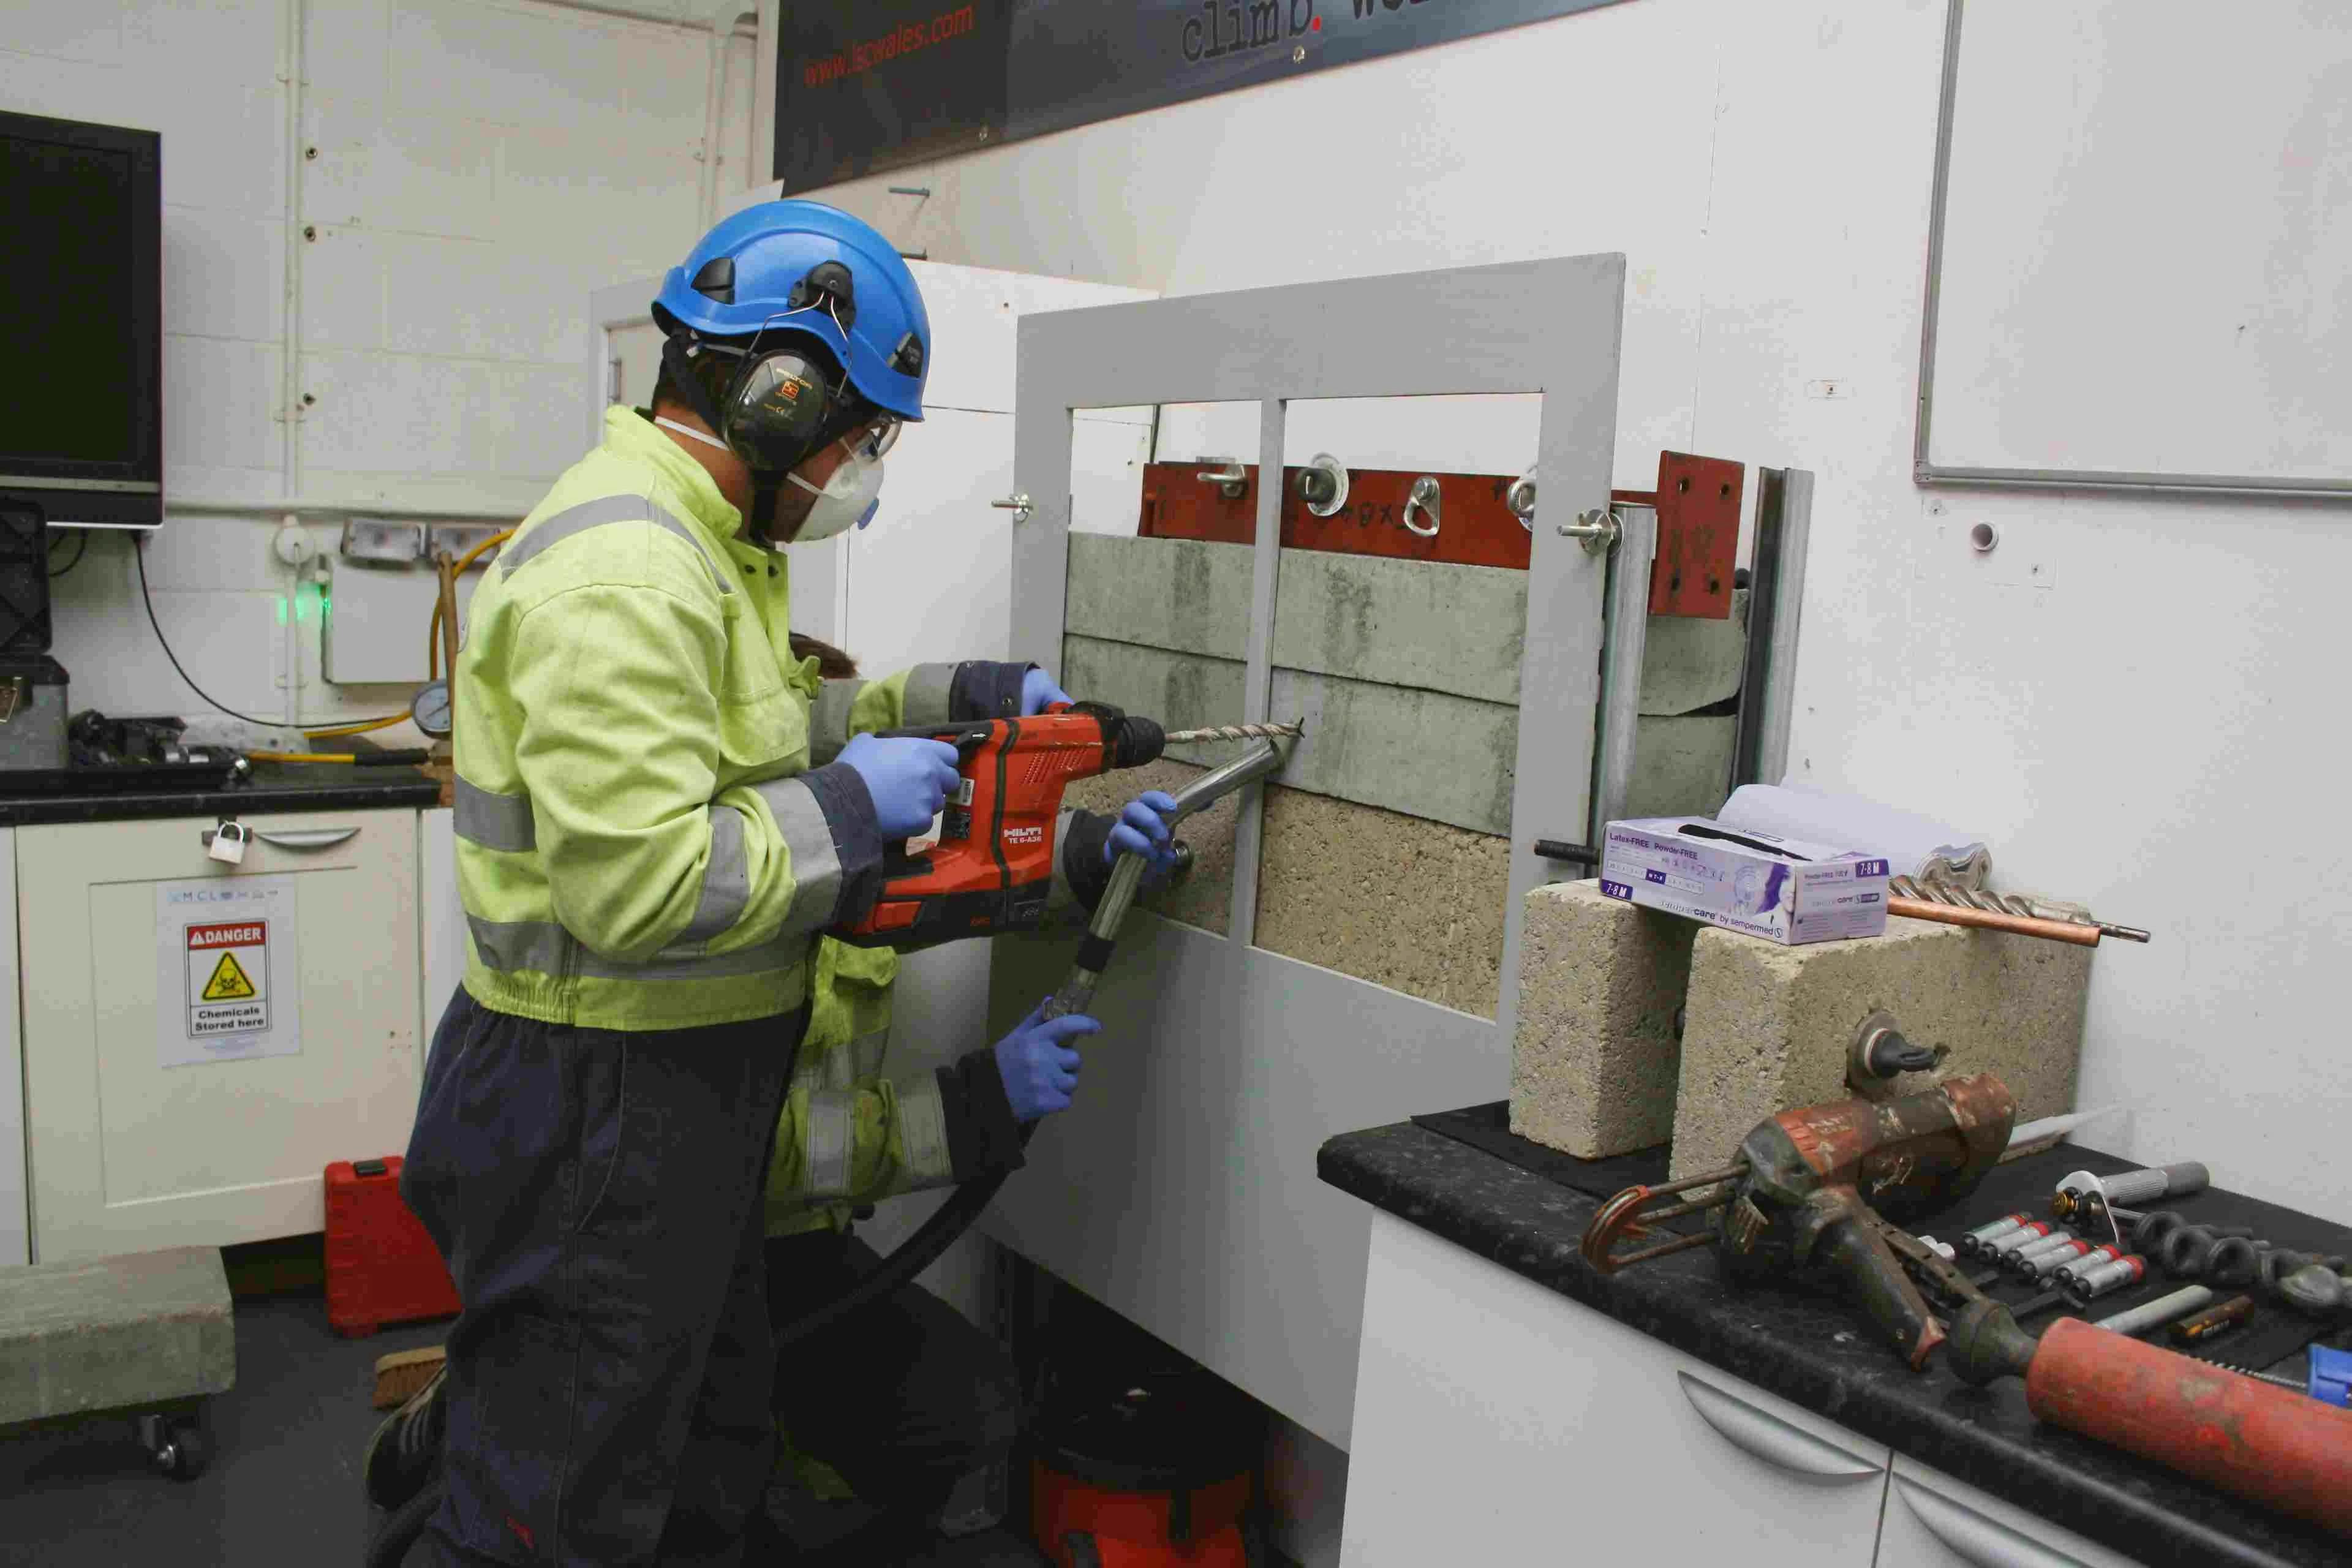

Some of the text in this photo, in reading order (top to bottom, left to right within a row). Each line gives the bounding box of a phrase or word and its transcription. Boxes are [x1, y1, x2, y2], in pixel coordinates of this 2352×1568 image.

[1610, 832, 1649, 848] Latex-FREE
[1654, 842, 1698, 861] Powder-FREE
[1619, 886, 1627, 897] M
[1720, 914, 1729, 925] by
[1730, 918, 1774, 935] sempermed
[205, 927, 262, 944] DANGER
[199, 1006, 260, 1019] Chemicals
[195, 1019, 264, 1031] Stored here
